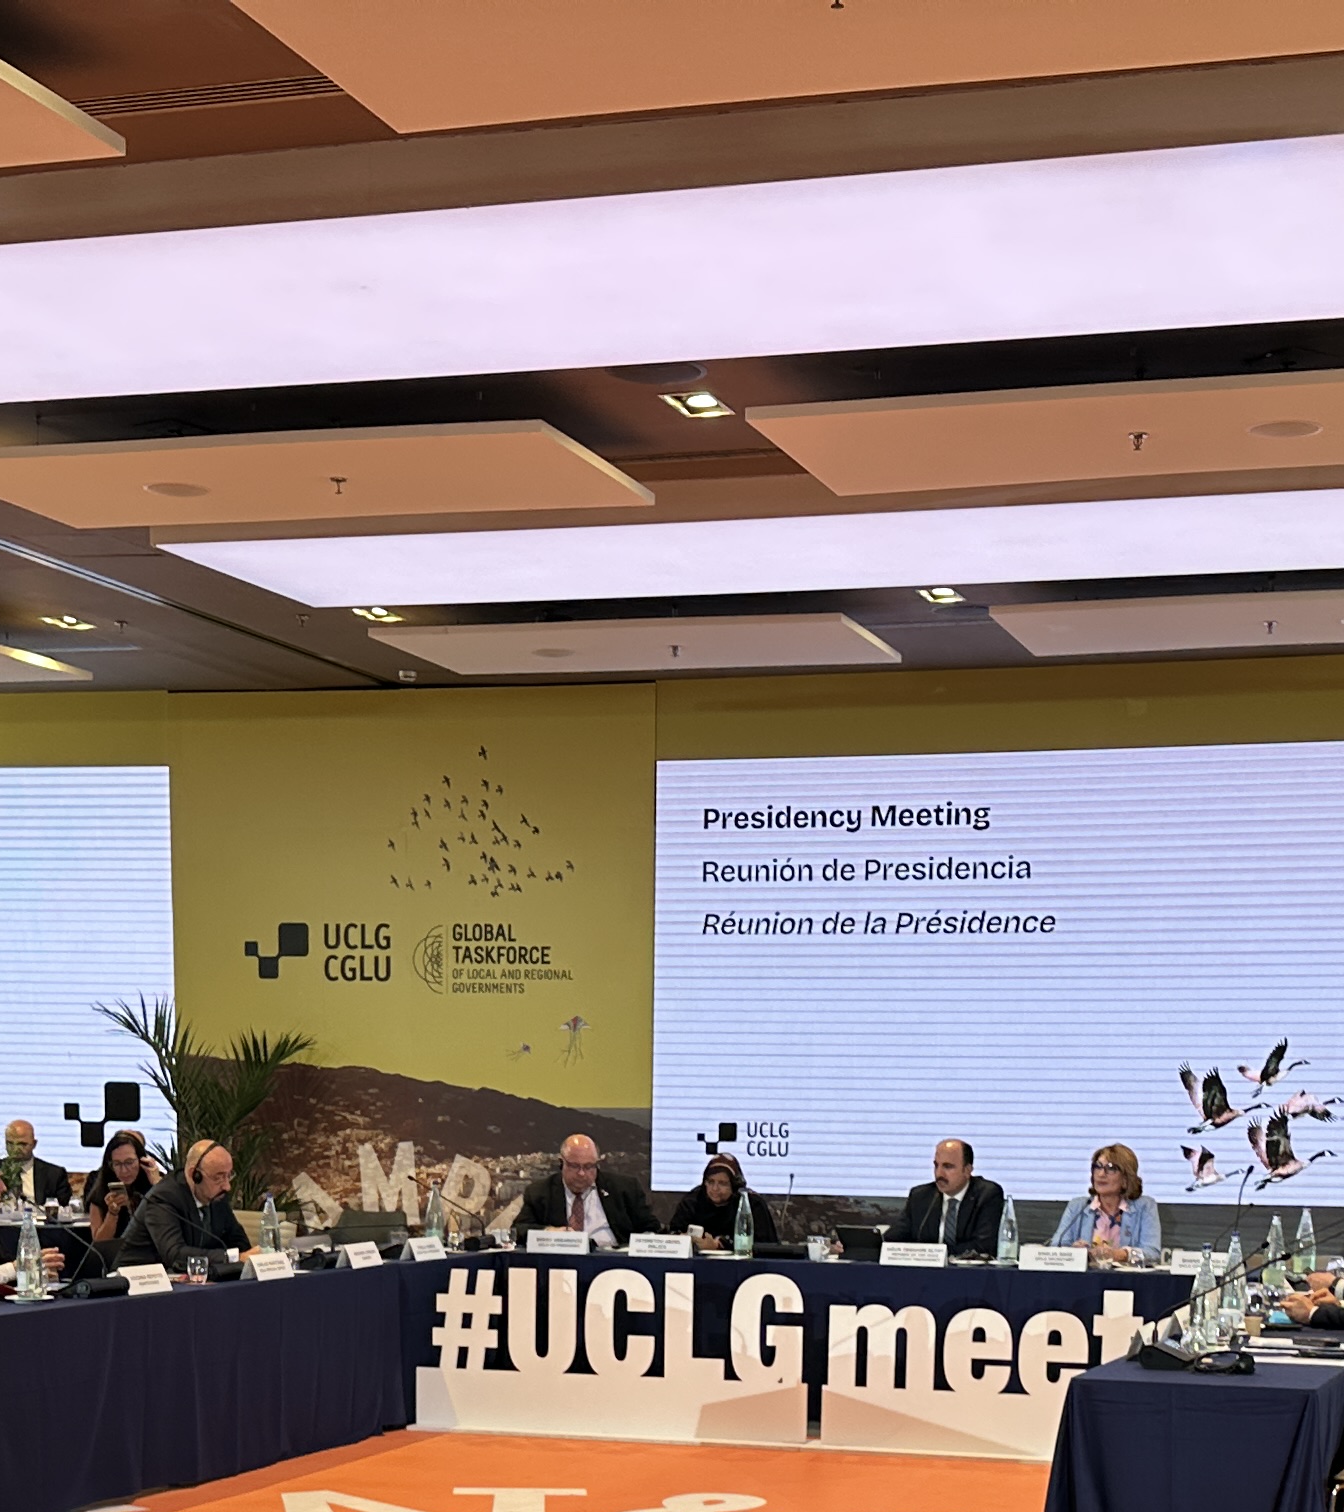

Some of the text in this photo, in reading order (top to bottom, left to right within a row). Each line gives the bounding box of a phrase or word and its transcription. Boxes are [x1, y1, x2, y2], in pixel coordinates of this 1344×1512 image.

[703, 802, 991, 833] Presidency Meeting
[702, 855, 1031, 883] Reunión de Presidencia
[452, 923, 516, 942] GLOBAL
[703, 909, 1056, 936] Réunion de la Présidence
[323, 923, 391, 950] UCLG
[452, 946, 551, 965] TASKFORCE
[324, 955, 391, 982] CGLU
[452, 969, 573, 981] OF LOCAL AND REGIONAL
[452, 983, 525, 994] GOVERNMENTS
[746, 1122, 789, 1138] UCLG
[746, 1140, 789, 1157] CGLU
[828, 1289, 1172, 1397] meet
